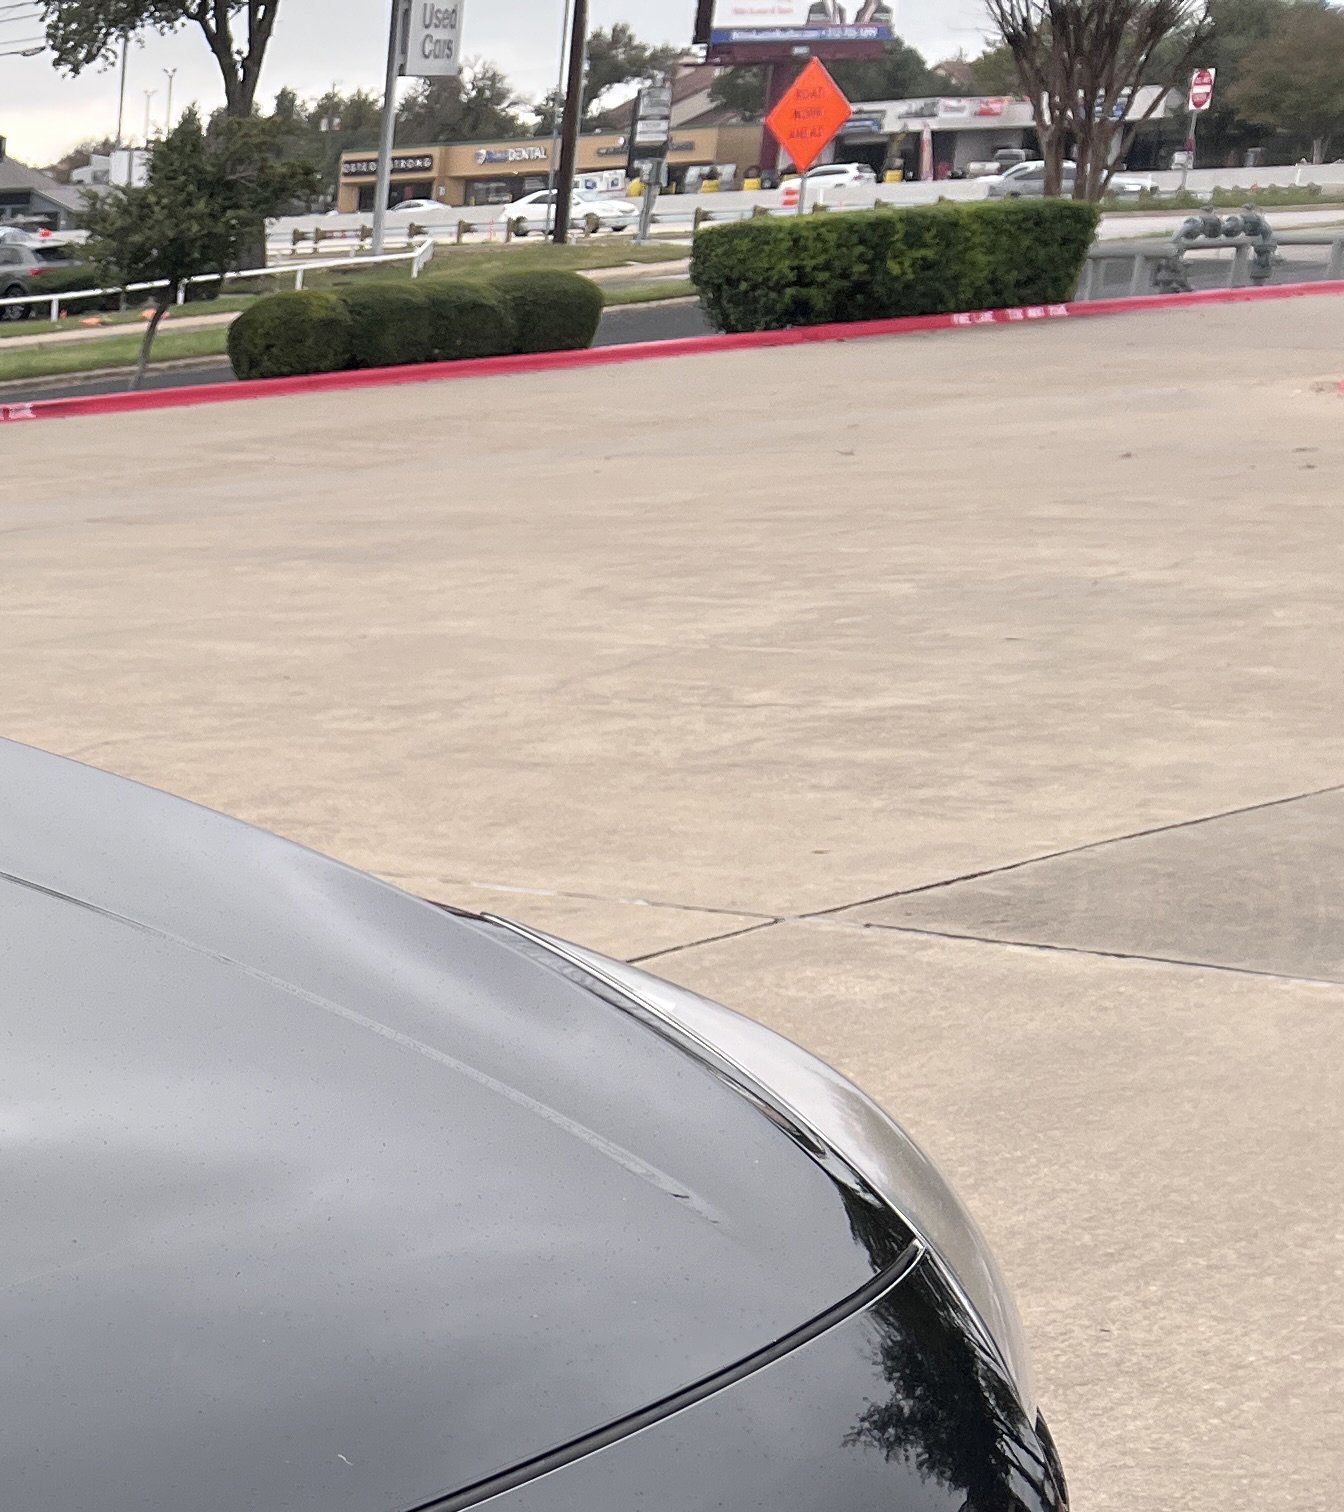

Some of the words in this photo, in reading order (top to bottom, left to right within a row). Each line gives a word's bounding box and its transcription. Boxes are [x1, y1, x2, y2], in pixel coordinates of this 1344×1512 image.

[423, 3, 458, 29] Used
[422, 34, 454, 59] Cars
[508, 146, 547, 161] DENTAL
